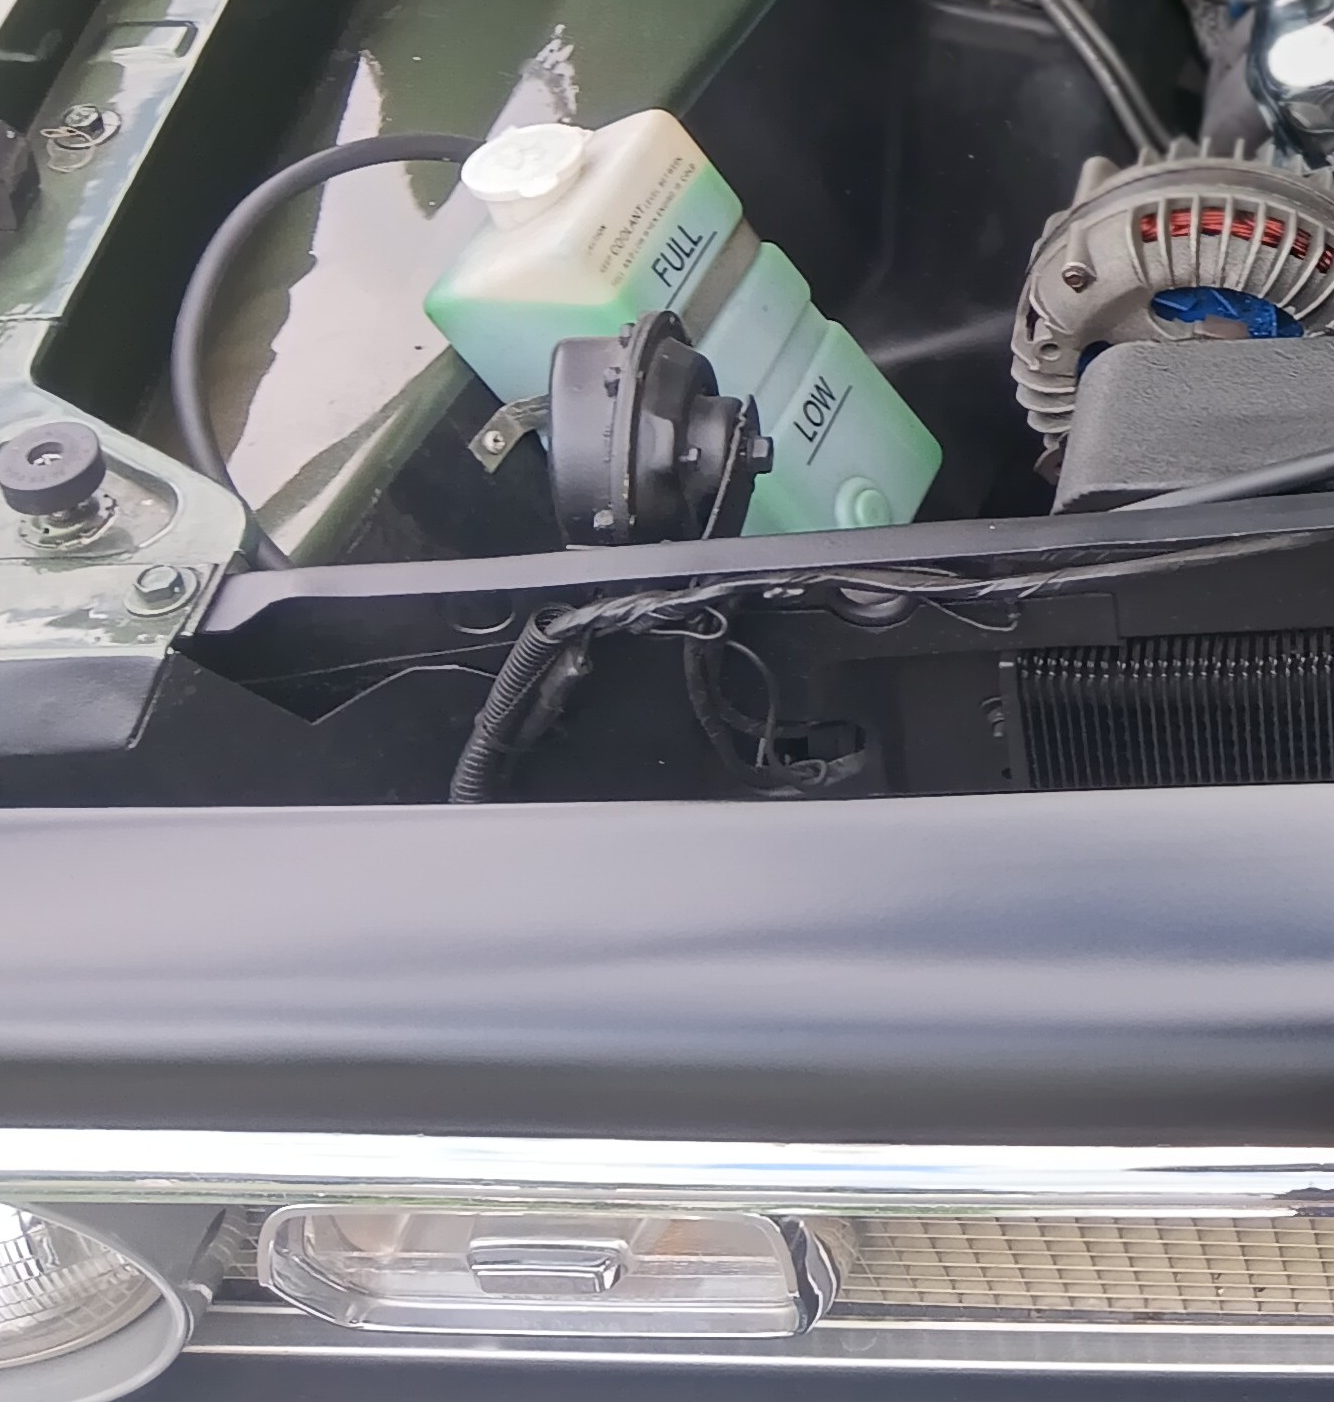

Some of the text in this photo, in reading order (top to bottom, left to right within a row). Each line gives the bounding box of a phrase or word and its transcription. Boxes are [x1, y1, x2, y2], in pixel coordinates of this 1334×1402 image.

[609, 203, 645, 256] COOLANT
[651, 224, 703, 288] FULL
[793, 375, 836, 442] LOW
